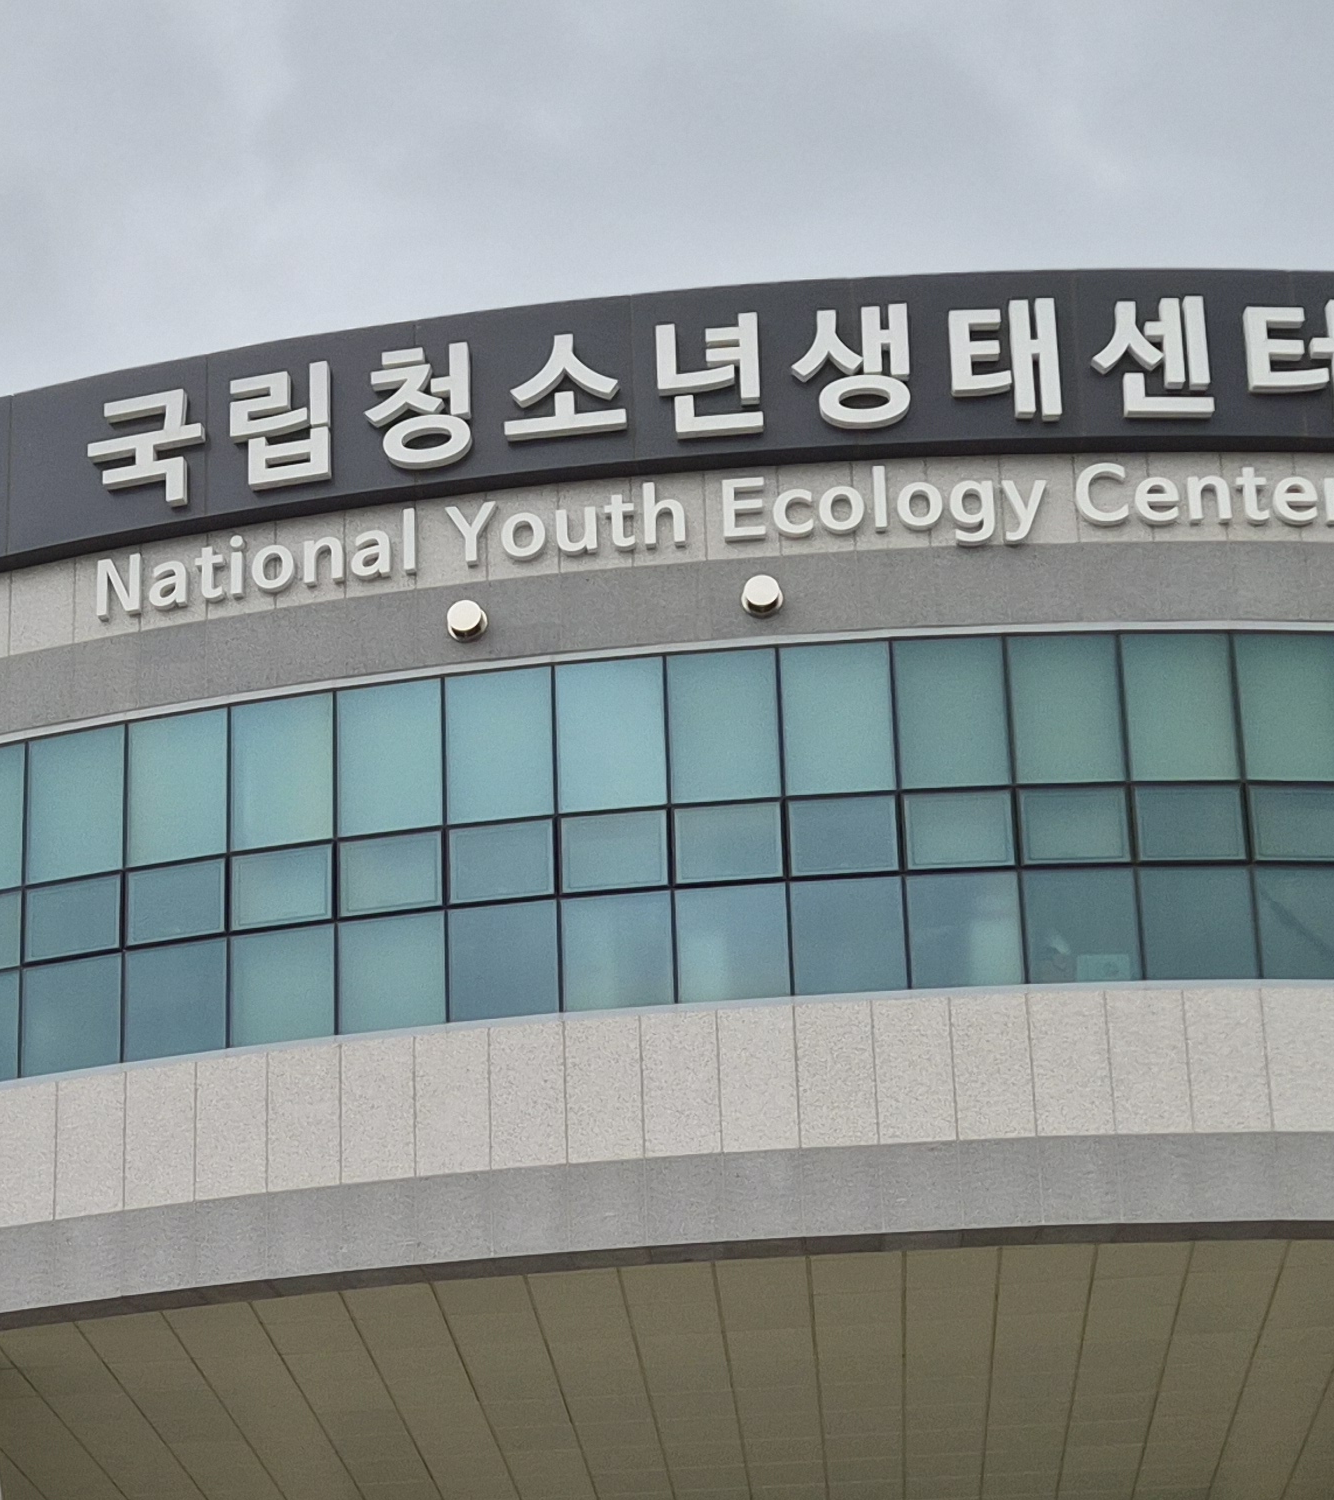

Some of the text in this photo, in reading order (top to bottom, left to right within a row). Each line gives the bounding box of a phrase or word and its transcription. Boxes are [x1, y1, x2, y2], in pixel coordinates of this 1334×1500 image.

[95, 507, 417, 622] National
[445, 481, 687, 567] Youth
[721, 465, 1048, 546] Ecology
